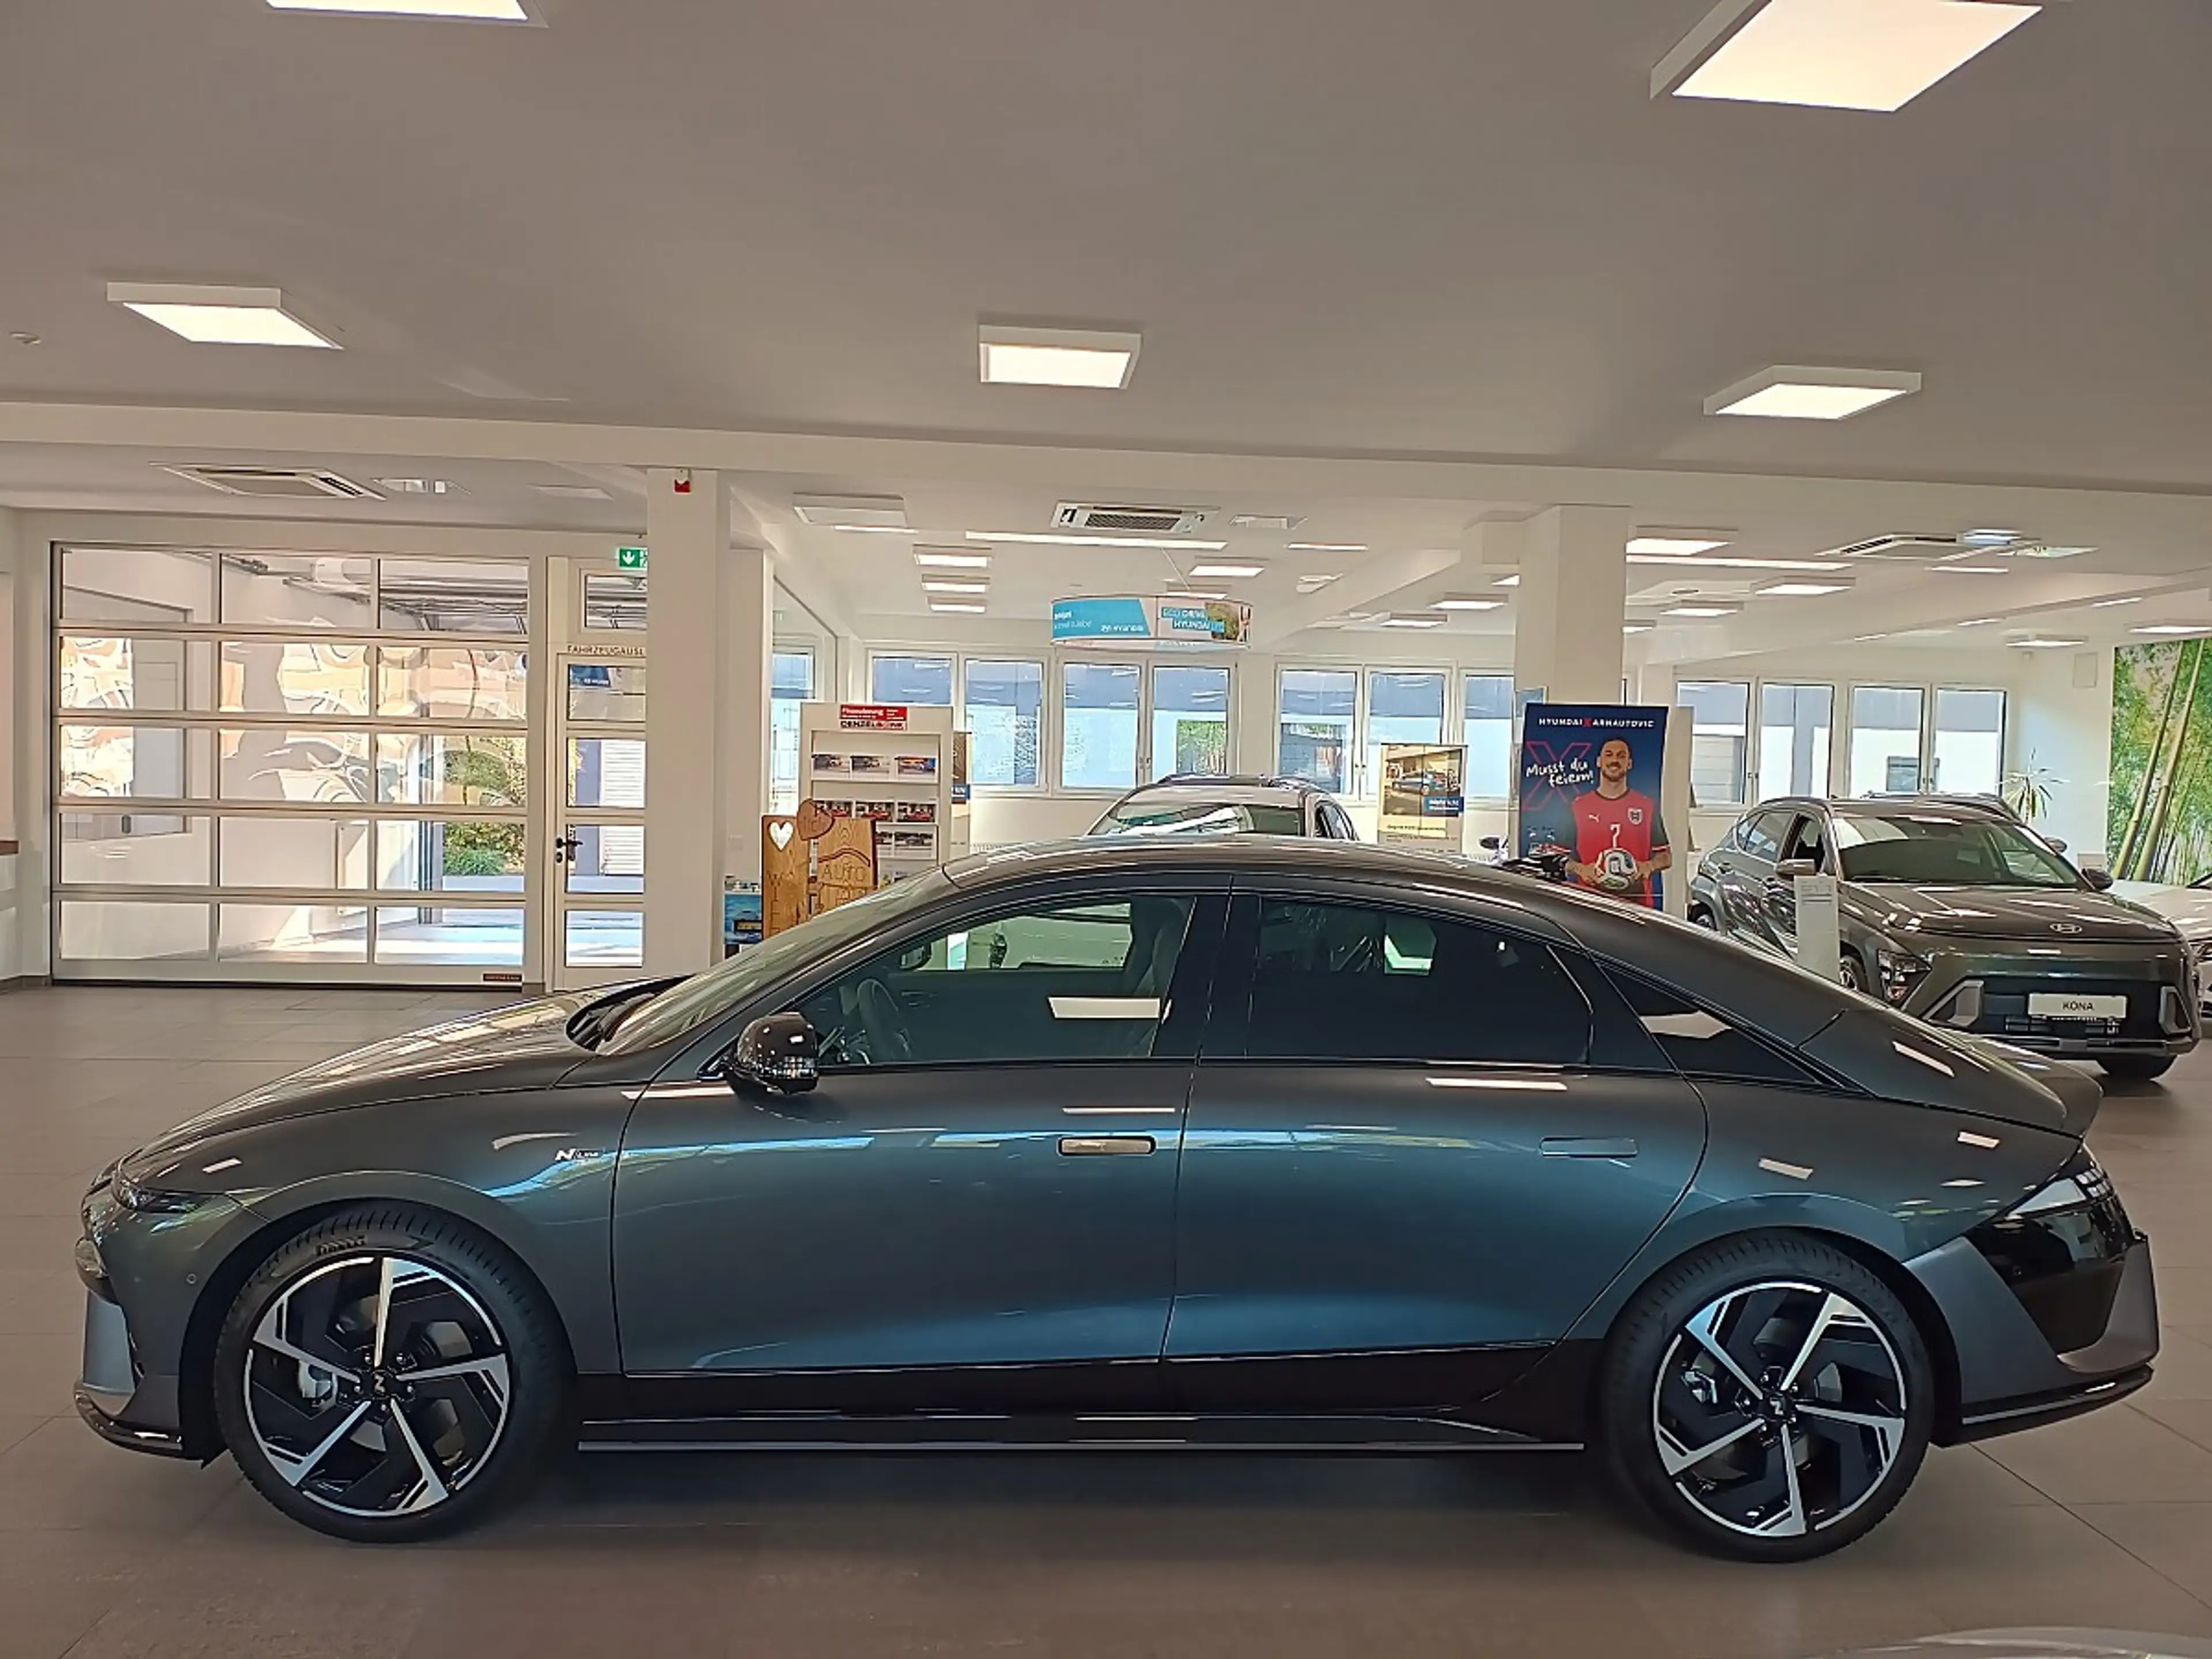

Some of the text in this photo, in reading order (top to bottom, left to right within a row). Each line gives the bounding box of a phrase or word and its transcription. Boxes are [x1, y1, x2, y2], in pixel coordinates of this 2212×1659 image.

[1173, 619, 1210, 630] HYUNDAI
[1592, 719, 1655, 728] ARNAUTOVIC
[1526, 757, 1588, 777] Musst du
[2062, 1001, 2094, 1011] KONA
